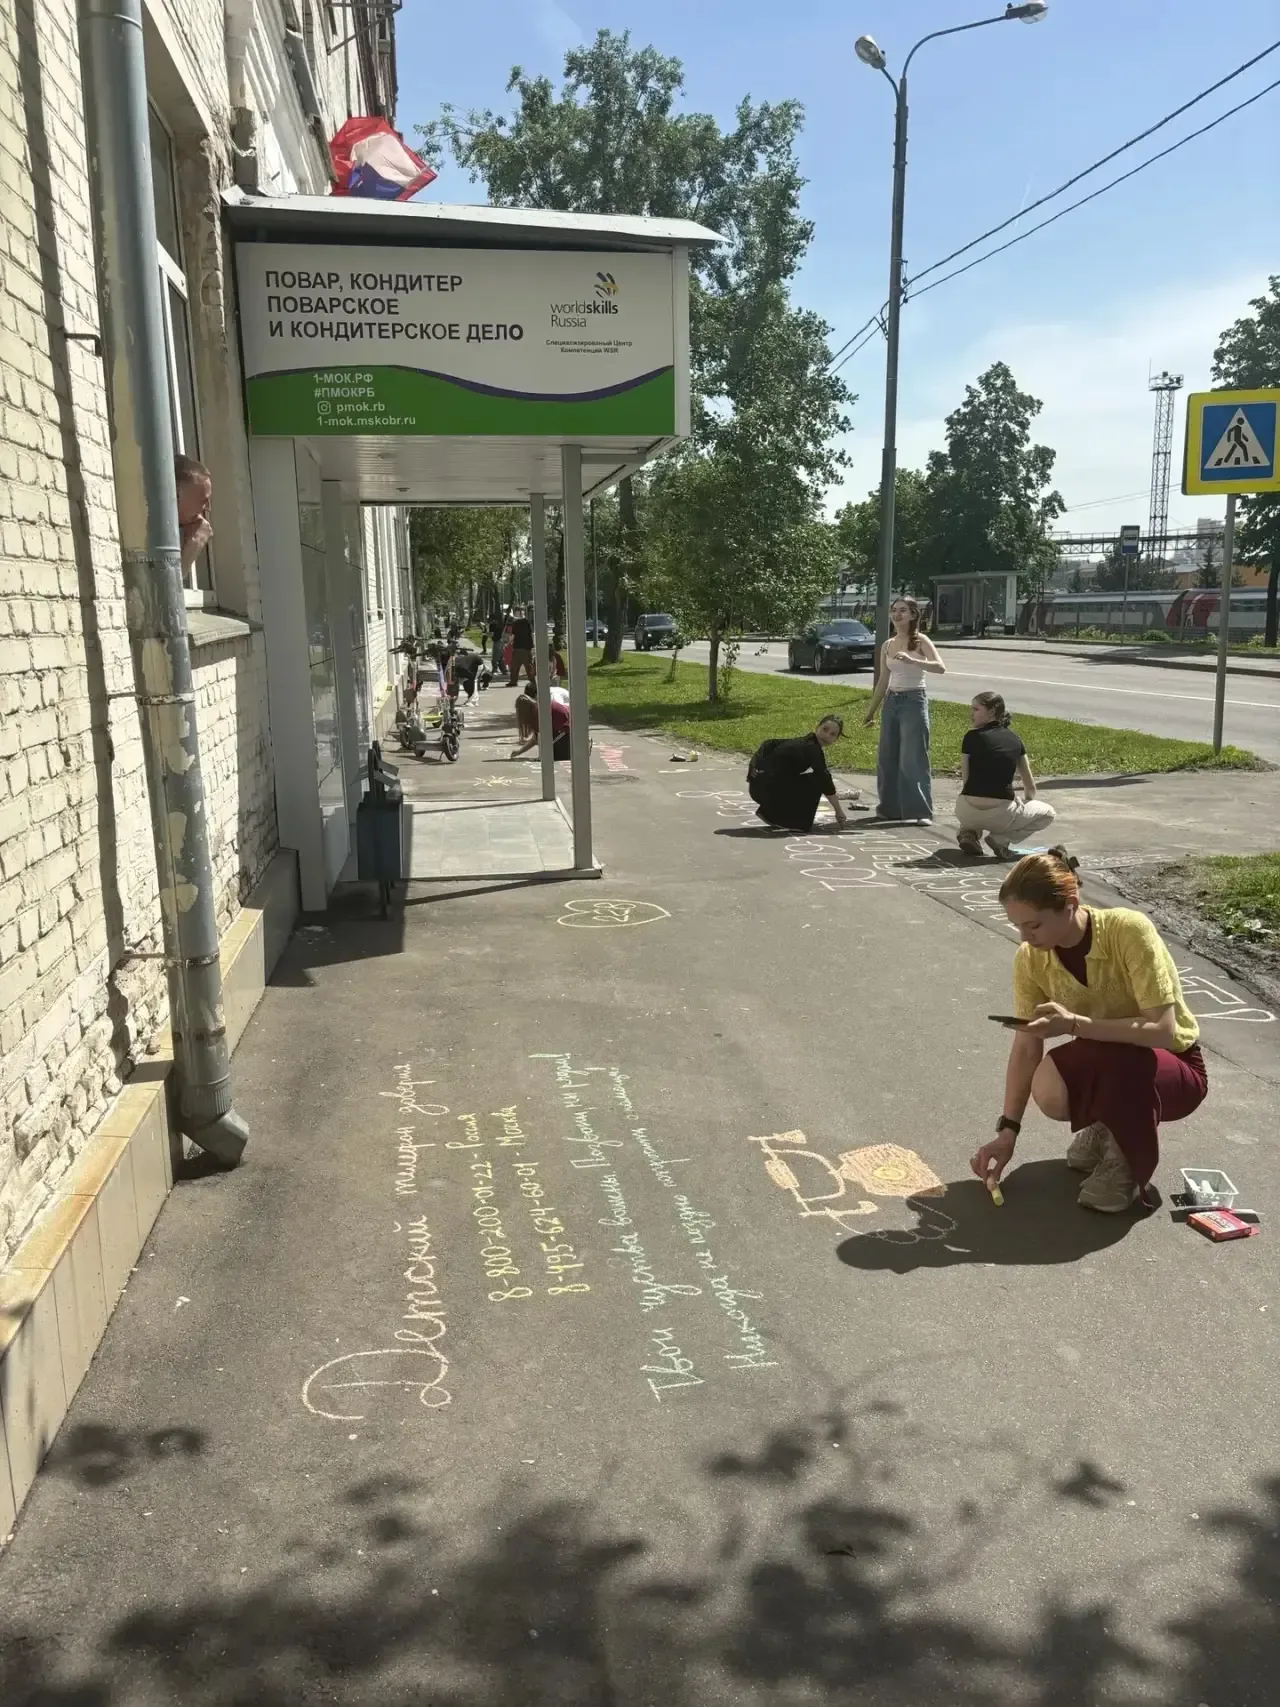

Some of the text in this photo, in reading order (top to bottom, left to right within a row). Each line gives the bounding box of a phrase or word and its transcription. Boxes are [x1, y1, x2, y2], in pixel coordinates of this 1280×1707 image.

[265, 271, 463, 294] ПОВАР, КОНДИТЕР
[267, 296, 400, 315] ПОВАРСКОЕ
[550, 299, 619, 314] worldskills
[269, 320, 524, 343] И КОНДИТЕРСКОЕ ДЕЛО
[551, 314, 587, 328] Russia
[613, 339, 633, 348] Центр
[313, 373, 374, 384] 1-МОК.РФ
[314, 387, 375, 398] #ПМОКРБ
[337, 401, 385, 413] pmok.rb
[317, 415, 416, 426] 1-mok.mskobr.ru
[592, 902, 637, 923] 228
[445, 1113, 485, 1149] Россия
[491, 1104, 526, 1146] Москва
[511, 1162, 591, 1296] 8-495-624-60-01
[673, 1194, 717, 1243] поздно
[302, 1064, 452, 1420] Детский телефон доверия
[472, 1160, 533, 1302] 8-800-200-01-22
[695, 1249, 717, 1269] не
[722, 1275, 779, 1369] Никогда
[639, 1327, 706, 1402] Твои
